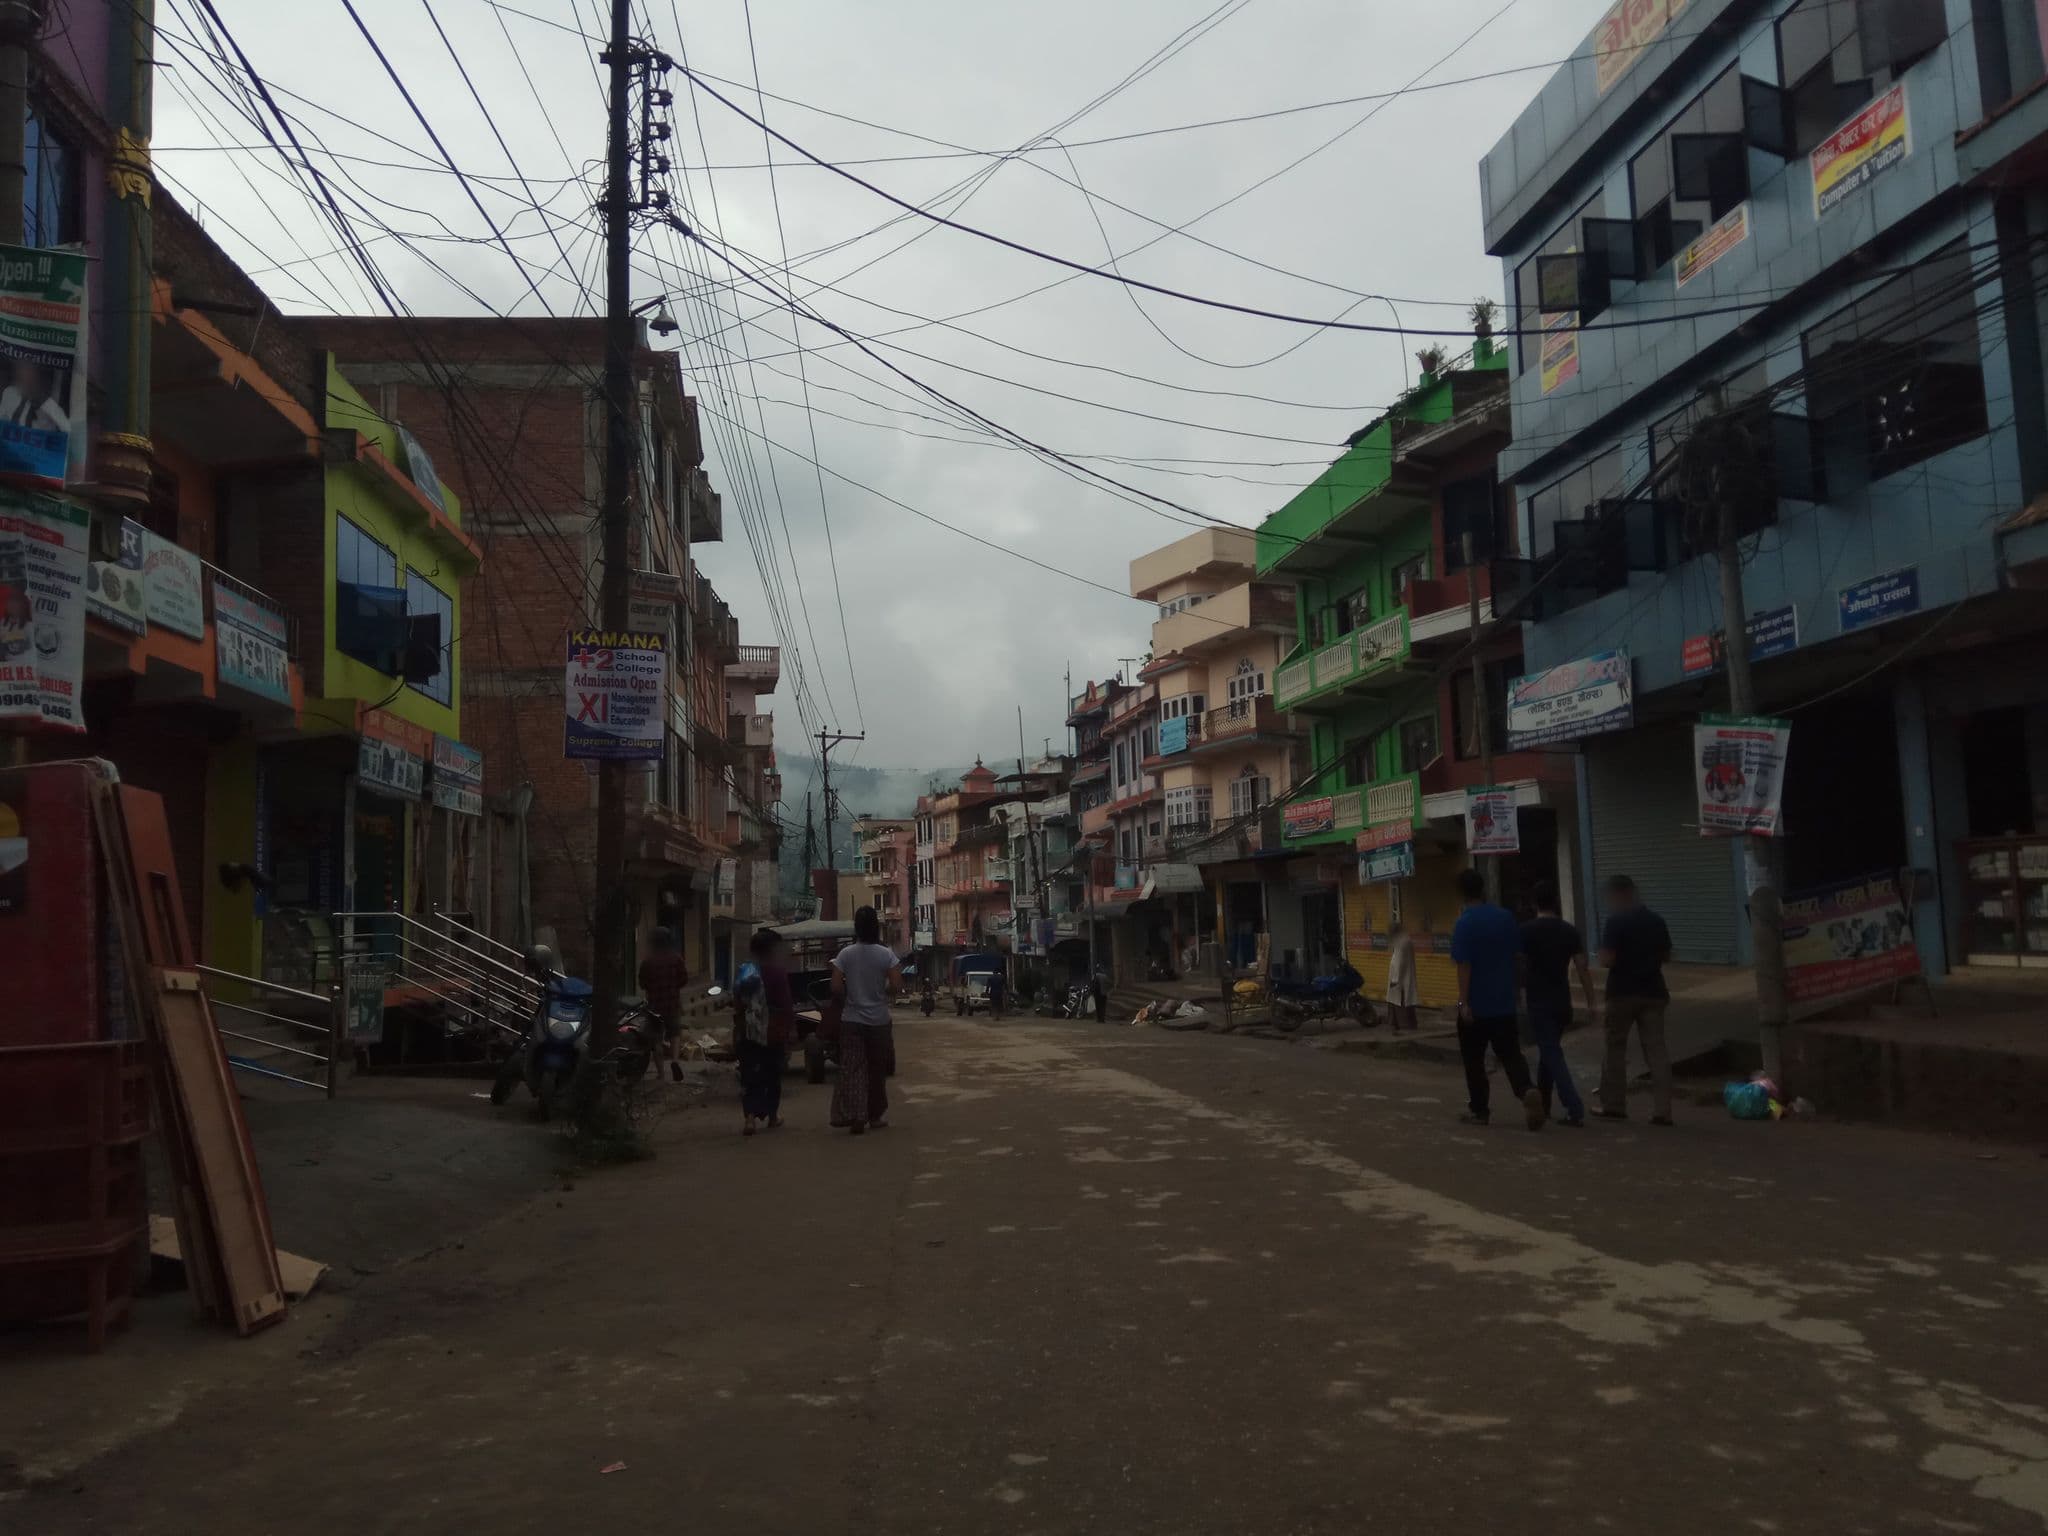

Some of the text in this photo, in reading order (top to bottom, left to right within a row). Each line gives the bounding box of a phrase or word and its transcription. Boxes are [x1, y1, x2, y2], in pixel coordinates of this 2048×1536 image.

[1820, 173, 1861, 210] Computer
[1862, 163, 1871, 178] &
[1871, 141, 1905, 171] Tuition
[1, 298, 78, 321] Management
[27, 562, 81, 584] nagement
[572, 631, 663, 650] KAMANA
[574, 648, 614, 671] +2
[616, 652, 657, 662] School
[615, 664, 661, 674] College
[574, 674, 657, 693] Admission Open
[577, 692, 608, 723] XI
[611, 692, 656, 705] Management
[611, 715, 646, 726] Education
[568, 735, 662, 749] Supreme College
